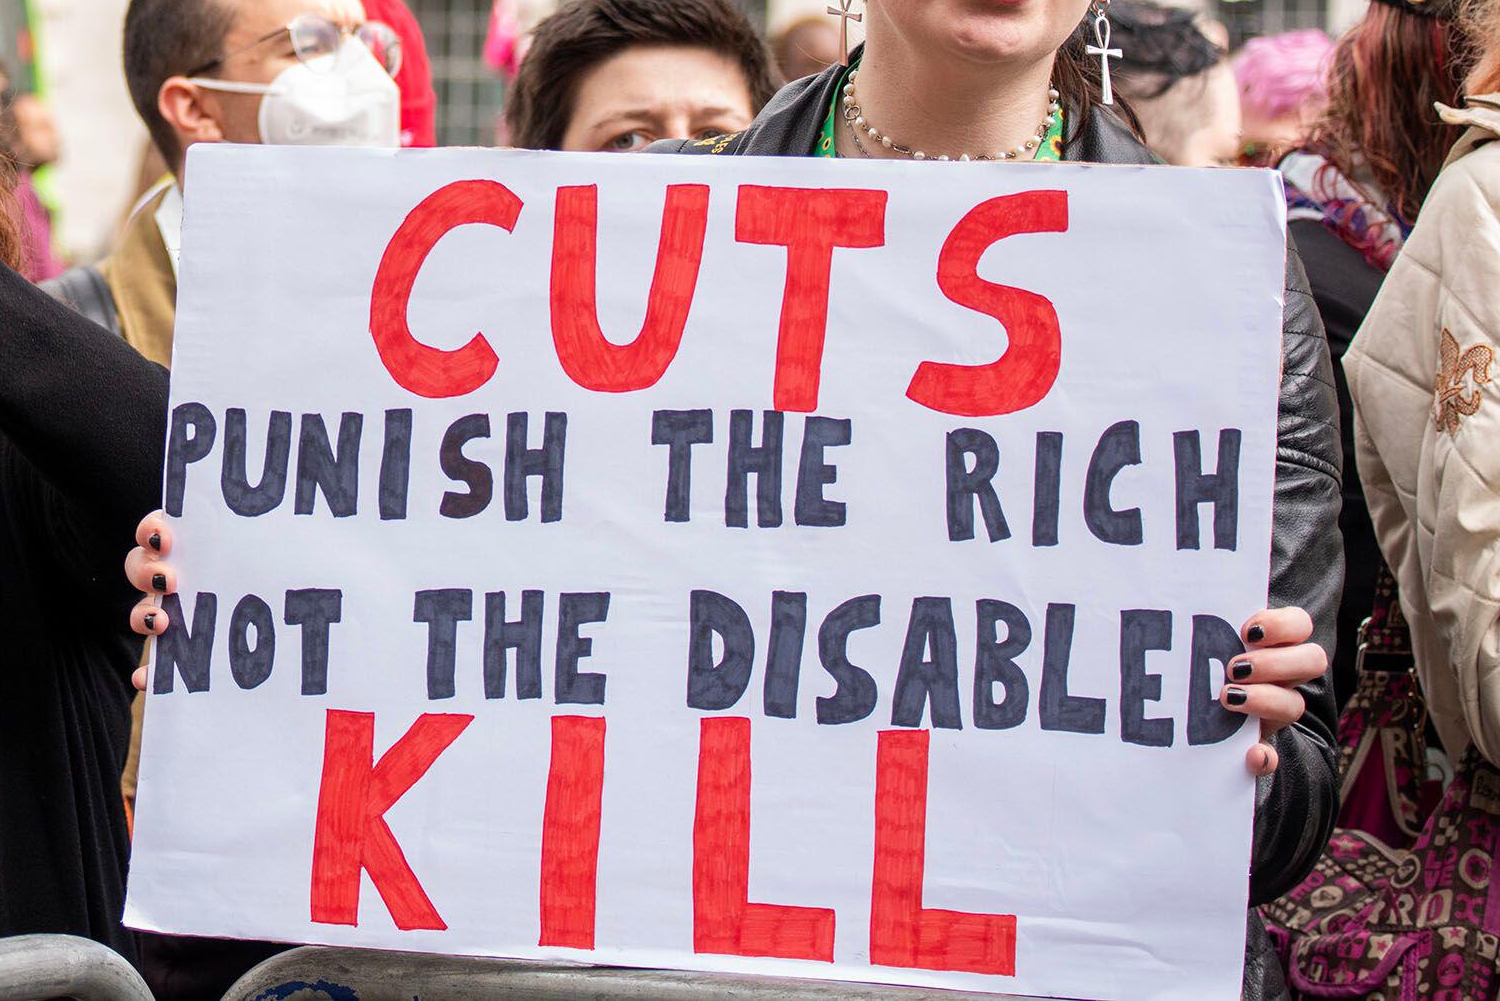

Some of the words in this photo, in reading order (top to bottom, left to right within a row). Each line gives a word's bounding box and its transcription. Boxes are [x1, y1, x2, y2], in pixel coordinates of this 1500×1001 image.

[369, 179, 1069, 418] CUTS
[164, 403, 567, 523] PUNISH
[651, 409, 852, 529] THE
[946, 420, 1242, 551] RICH
[153, 588, 343, 696] NOT
[413, 588, 611, 705] THE
[687, 589, 1248, 747] DISABLED
[309, 708, 1017, 977] KILL
